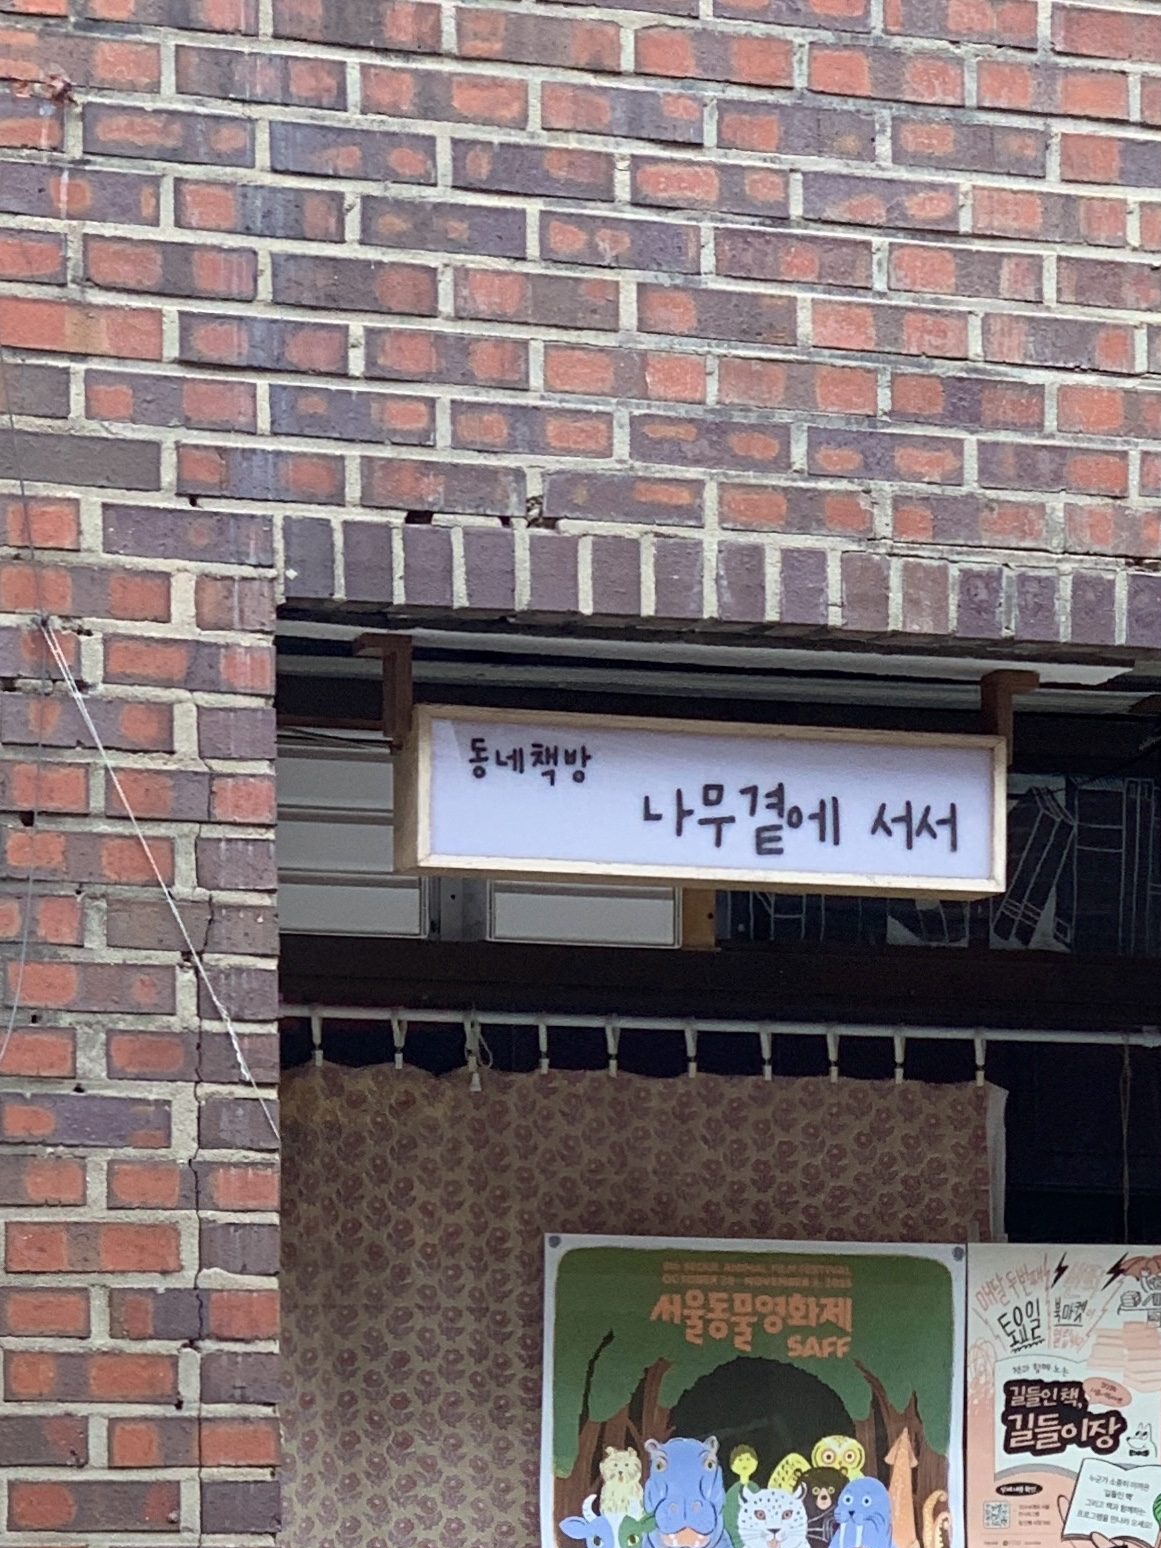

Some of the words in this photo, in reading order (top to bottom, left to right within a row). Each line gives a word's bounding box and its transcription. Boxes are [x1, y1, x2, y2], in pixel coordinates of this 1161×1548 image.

[467, 736, 592, 786] 동네책방
[643, 780, 841, 856] 나무곁에
[869, 798, 959, 853] 서서
[650, 1288, 853, 1352] 서울동물영화제
[996, 1297, 1042, 1349] 토요일
[786, 1334, 852, 1359] SAFF
[1009, 1384, 1058, 1409] 길들인
[1007, 1412, 1122, 1451] 길들이장
